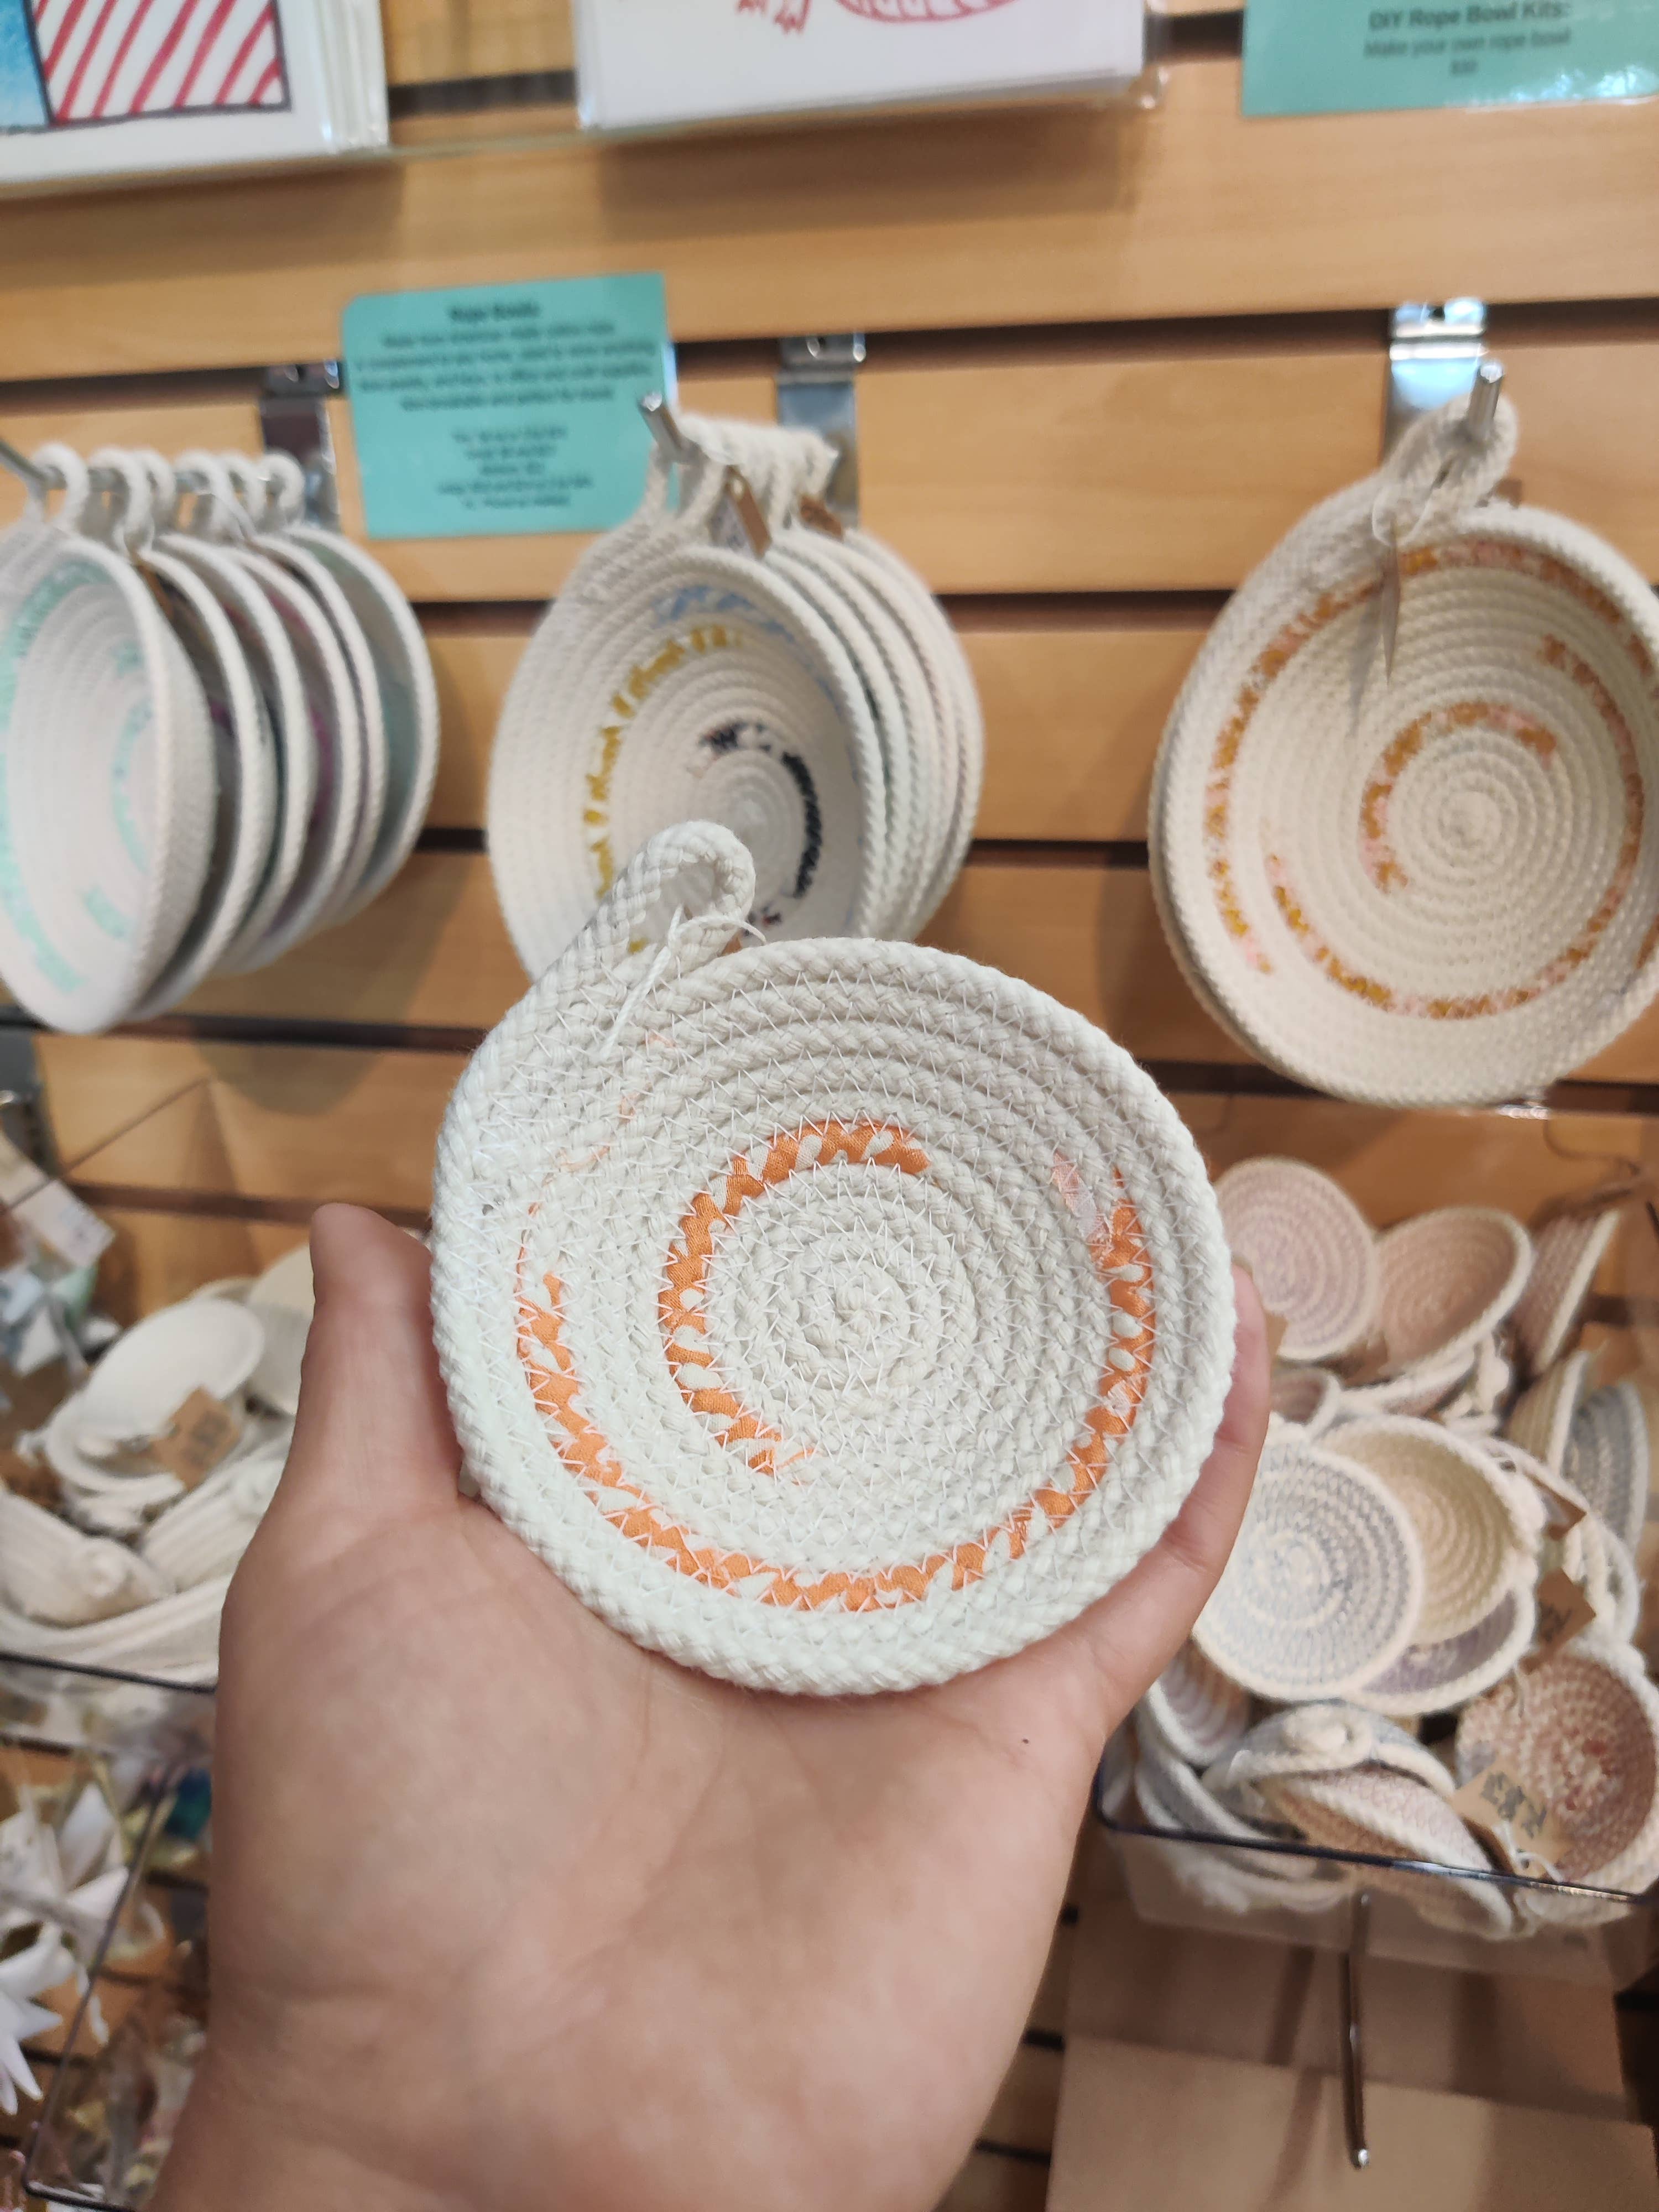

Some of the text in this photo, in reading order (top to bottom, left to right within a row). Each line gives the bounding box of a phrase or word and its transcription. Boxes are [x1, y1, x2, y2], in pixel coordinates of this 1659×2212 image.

[1369, 9, 1403, 30] DIY
[1409, 8, 1460, 29] Rope
[1466, 2, 1517, 23] Bowl
